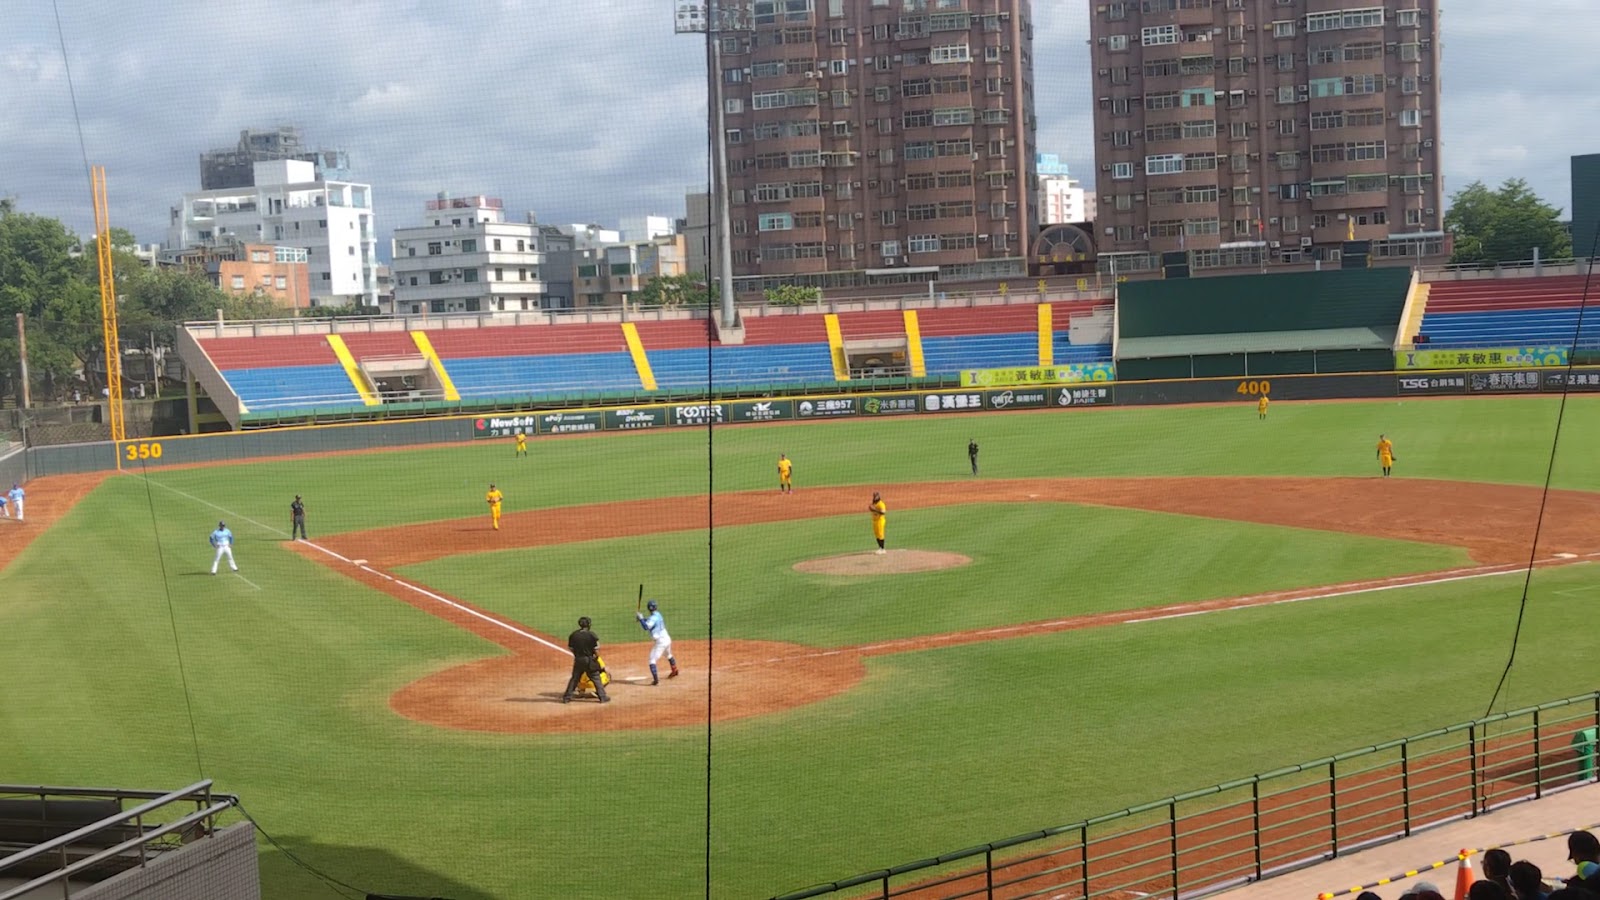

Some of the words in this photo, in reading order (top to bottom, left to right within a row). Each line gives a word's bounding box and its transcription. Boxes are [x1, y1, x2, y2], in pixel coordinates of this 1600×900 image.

[1457, 352, 1502, 365] 黃敏惠
[1016, 369, 1056, 381] 黃敏惠
[1488, 372, 1538, 385] 春雨集團
[1237, 380, 1271, 395] 400
[1399, 378, 1428, 389] TSG
[676, 405, 723, 418] FOOTER
[490, 416, 534, 428] NewSoft
[126, 443, 162, 460] 350
